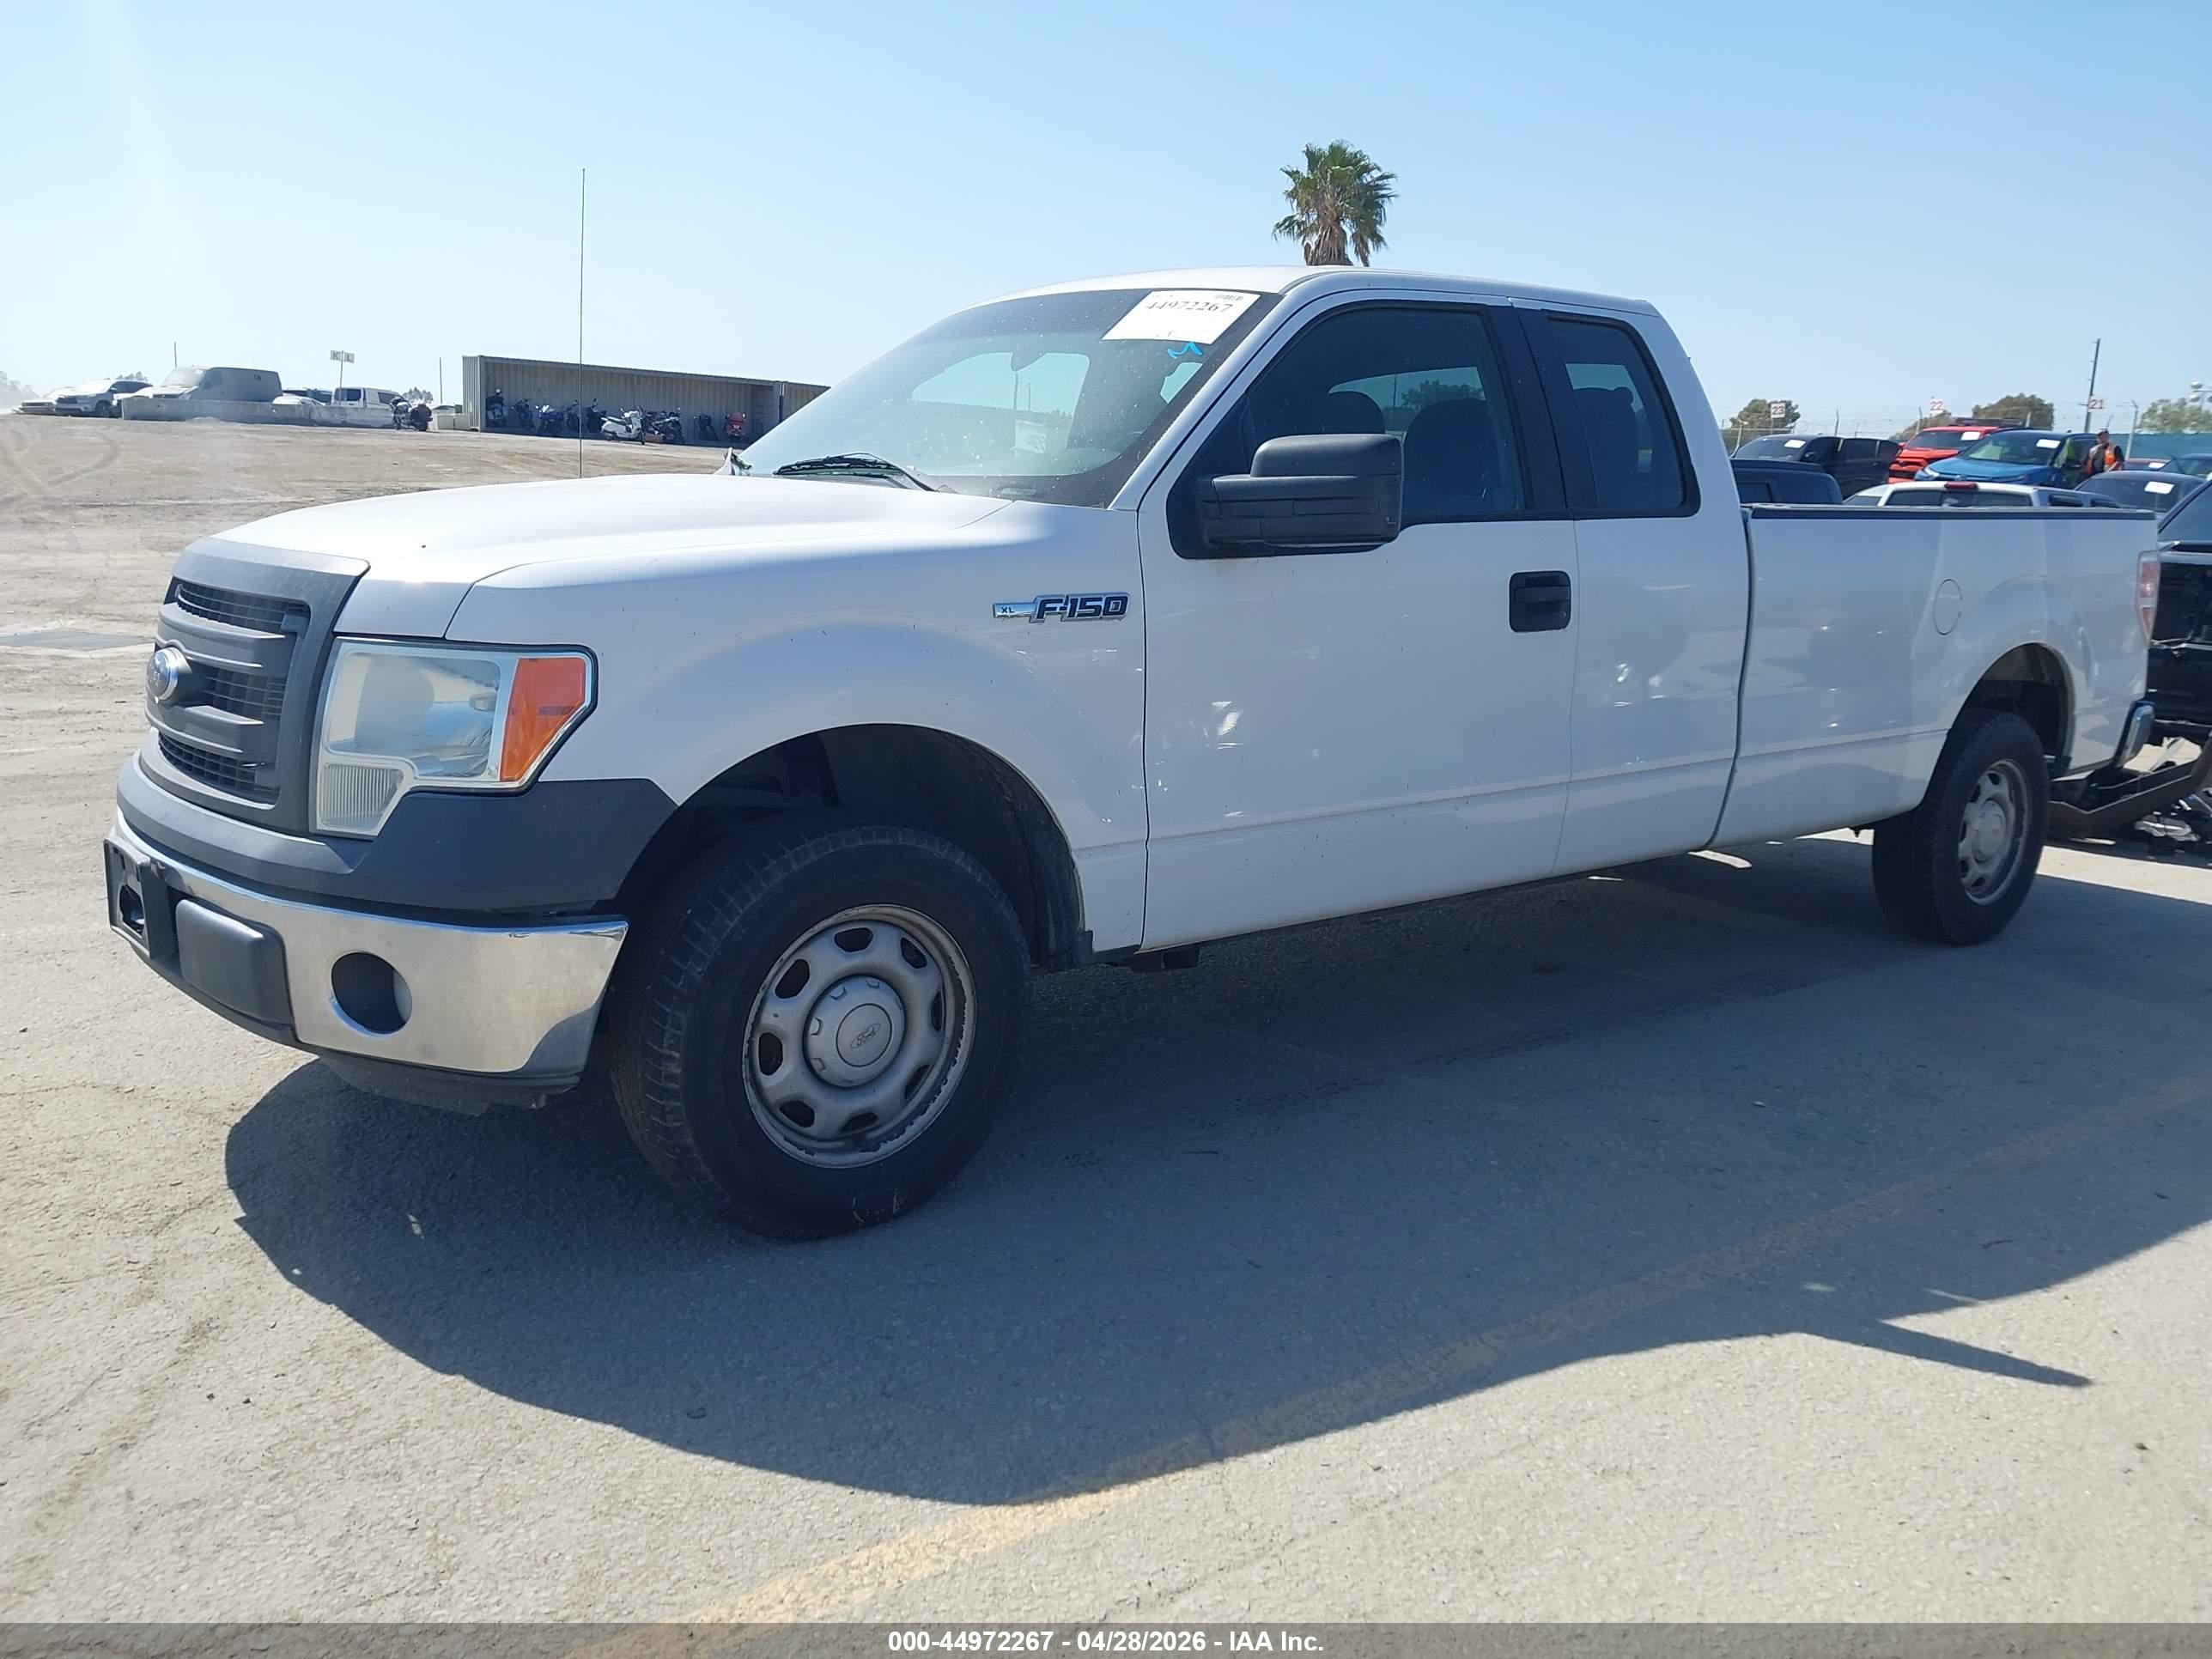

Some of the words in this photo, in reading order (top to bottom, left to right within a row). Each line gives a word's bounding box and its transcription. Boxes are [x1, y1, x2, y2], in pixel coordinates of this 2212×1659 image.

[1146, 301, 1233, 313] 44972267
[1771, 405, 1784, 415] 23
[1930, 400, 1943, 411] 22
[2089, 398, 2104, 410] 21
[1036, 594, 1129, 620] F-150
